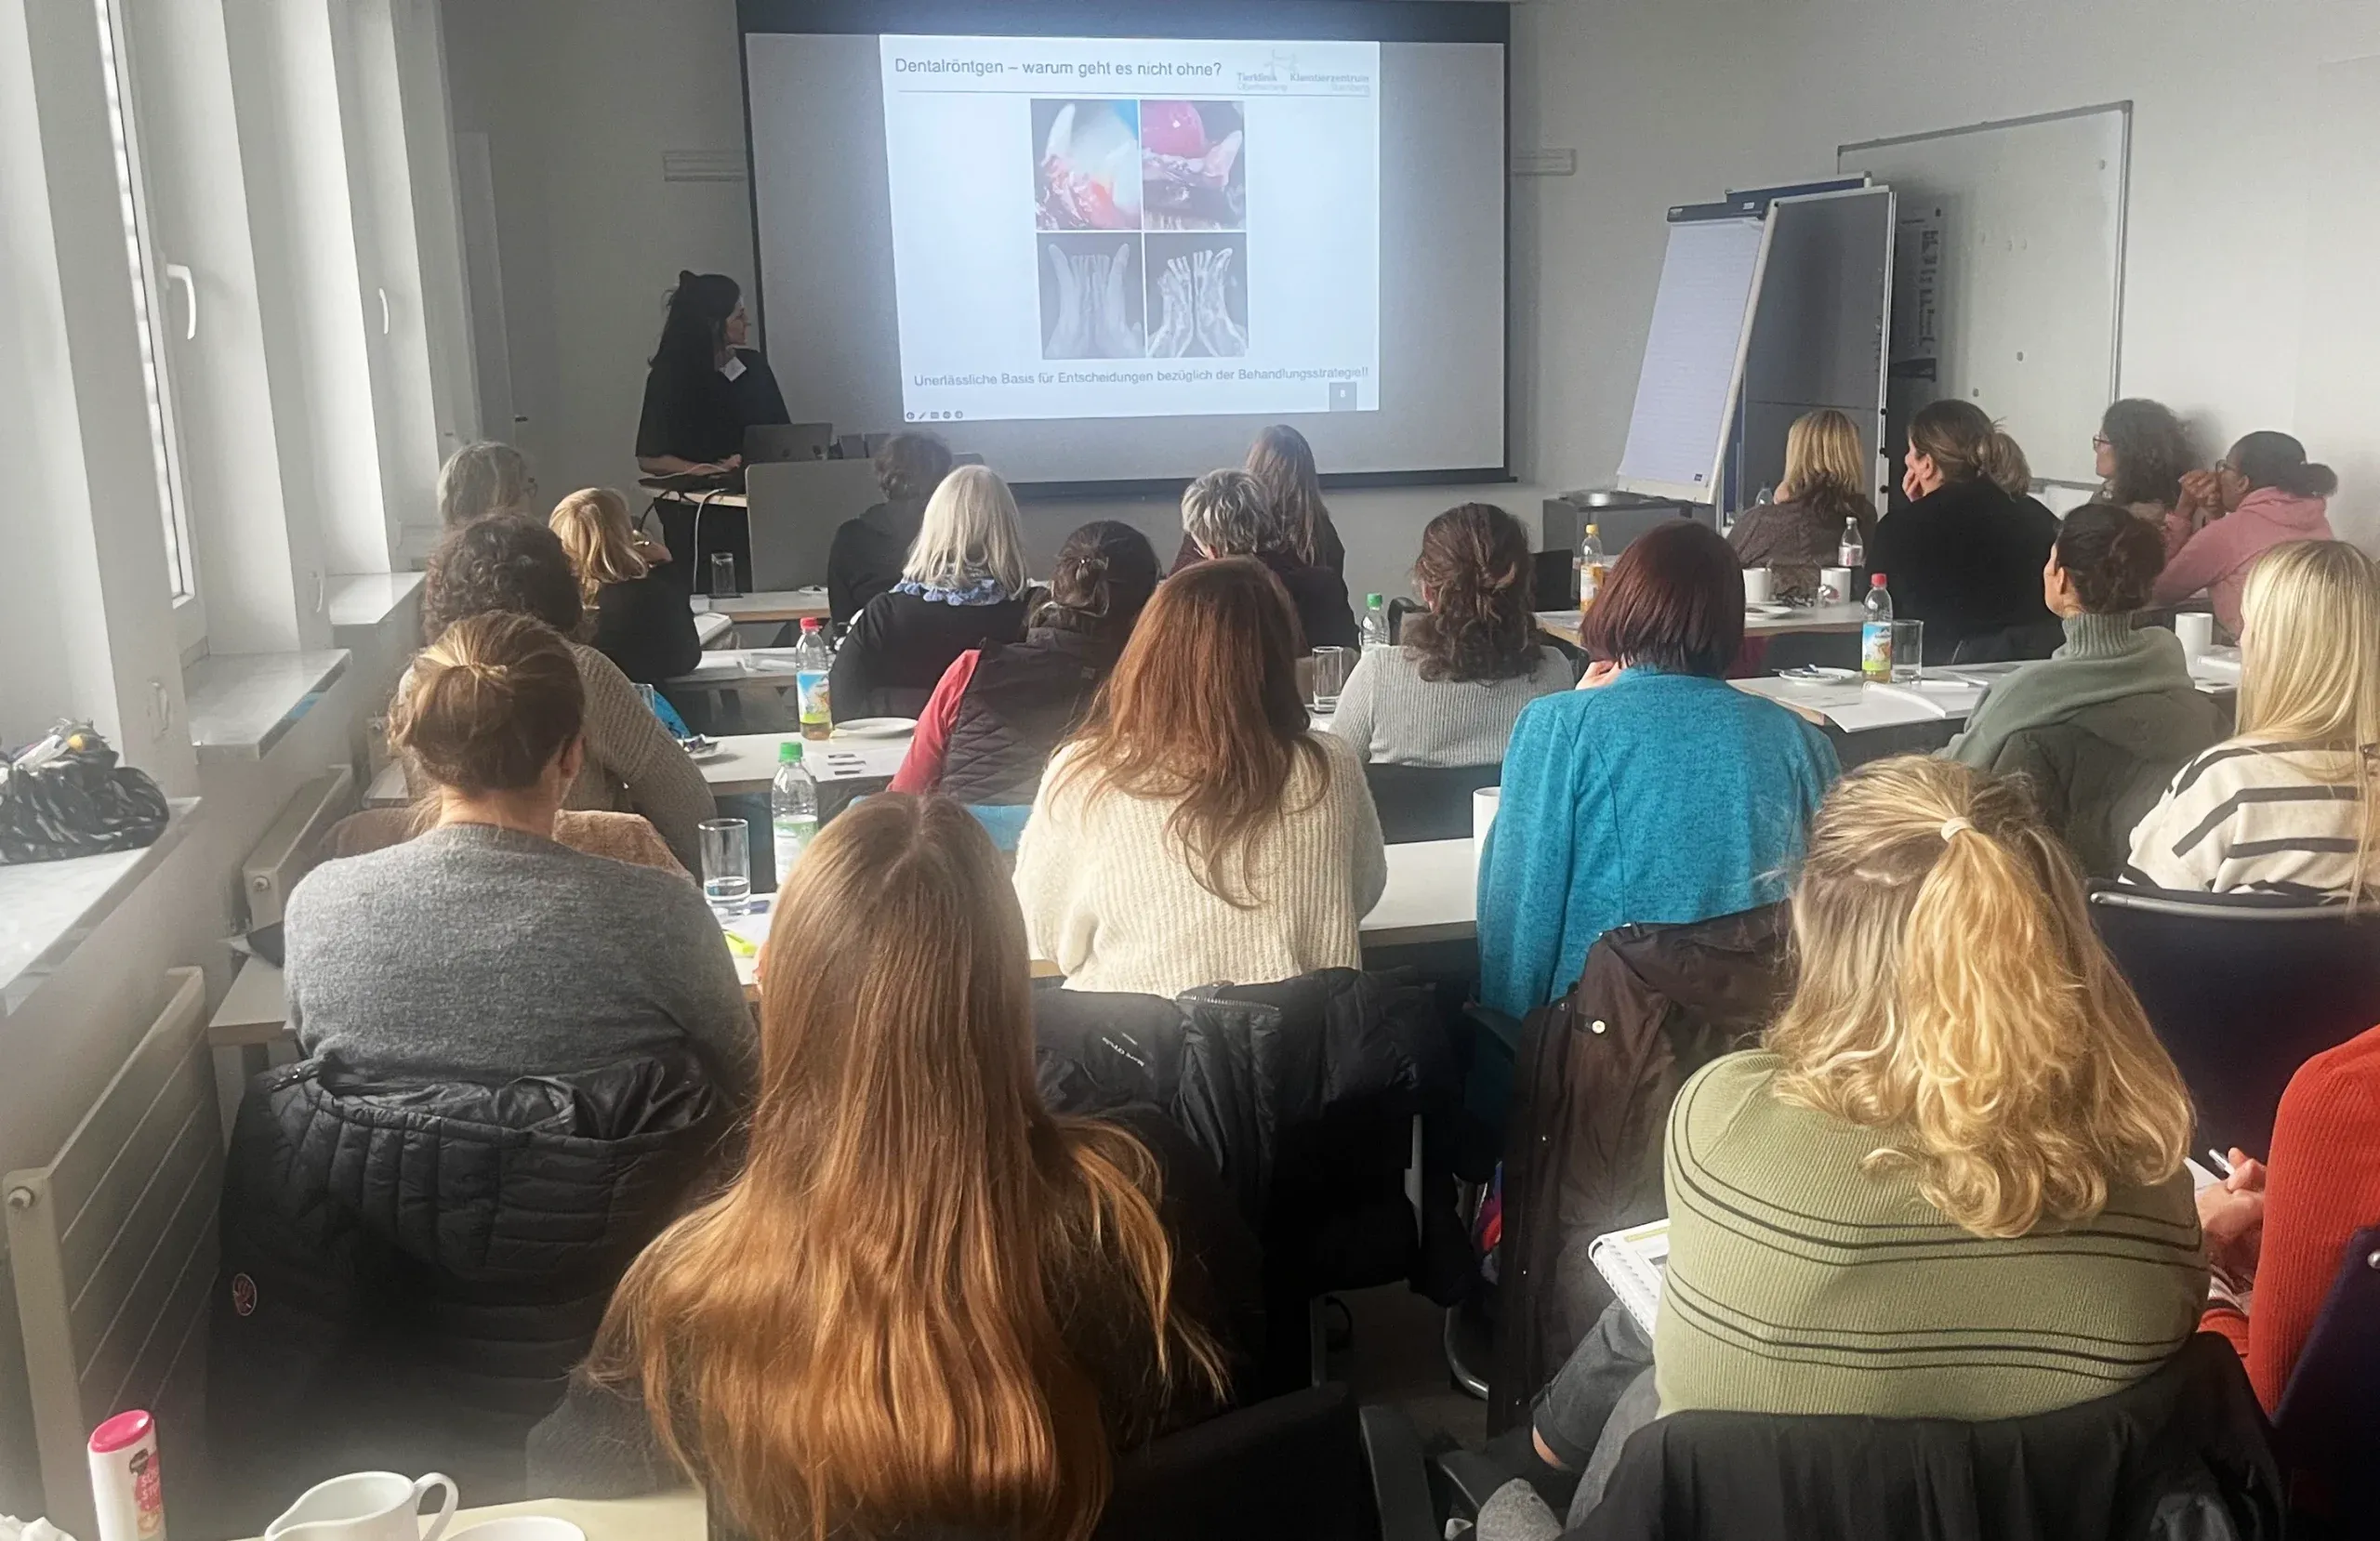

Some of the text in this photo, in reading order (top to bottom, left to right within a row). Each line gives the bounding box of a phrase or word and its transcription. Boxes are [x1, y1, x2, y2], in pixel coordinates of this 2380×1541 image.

[895, 58, 1004, 77] Dentalröntgen
[1022, 63, 1074, 74] warum
[1078, 61, 1111, 78] geht
[1116, 64, 1132, 75] es
[1137, 61, 1173, 75] nicht
[1176, 62, 1223, 76] ohne?
[914, 374, 998, 387] Unerlässliche
[1001, 373, 1035, 385] Basis
[1038, 372, 1054, 384] für
[1058, 372, 1154, 385] Entscheidungen
[1157, 370, 1212, 383] bezüglich
[1216, 369, 1235, 380] der
